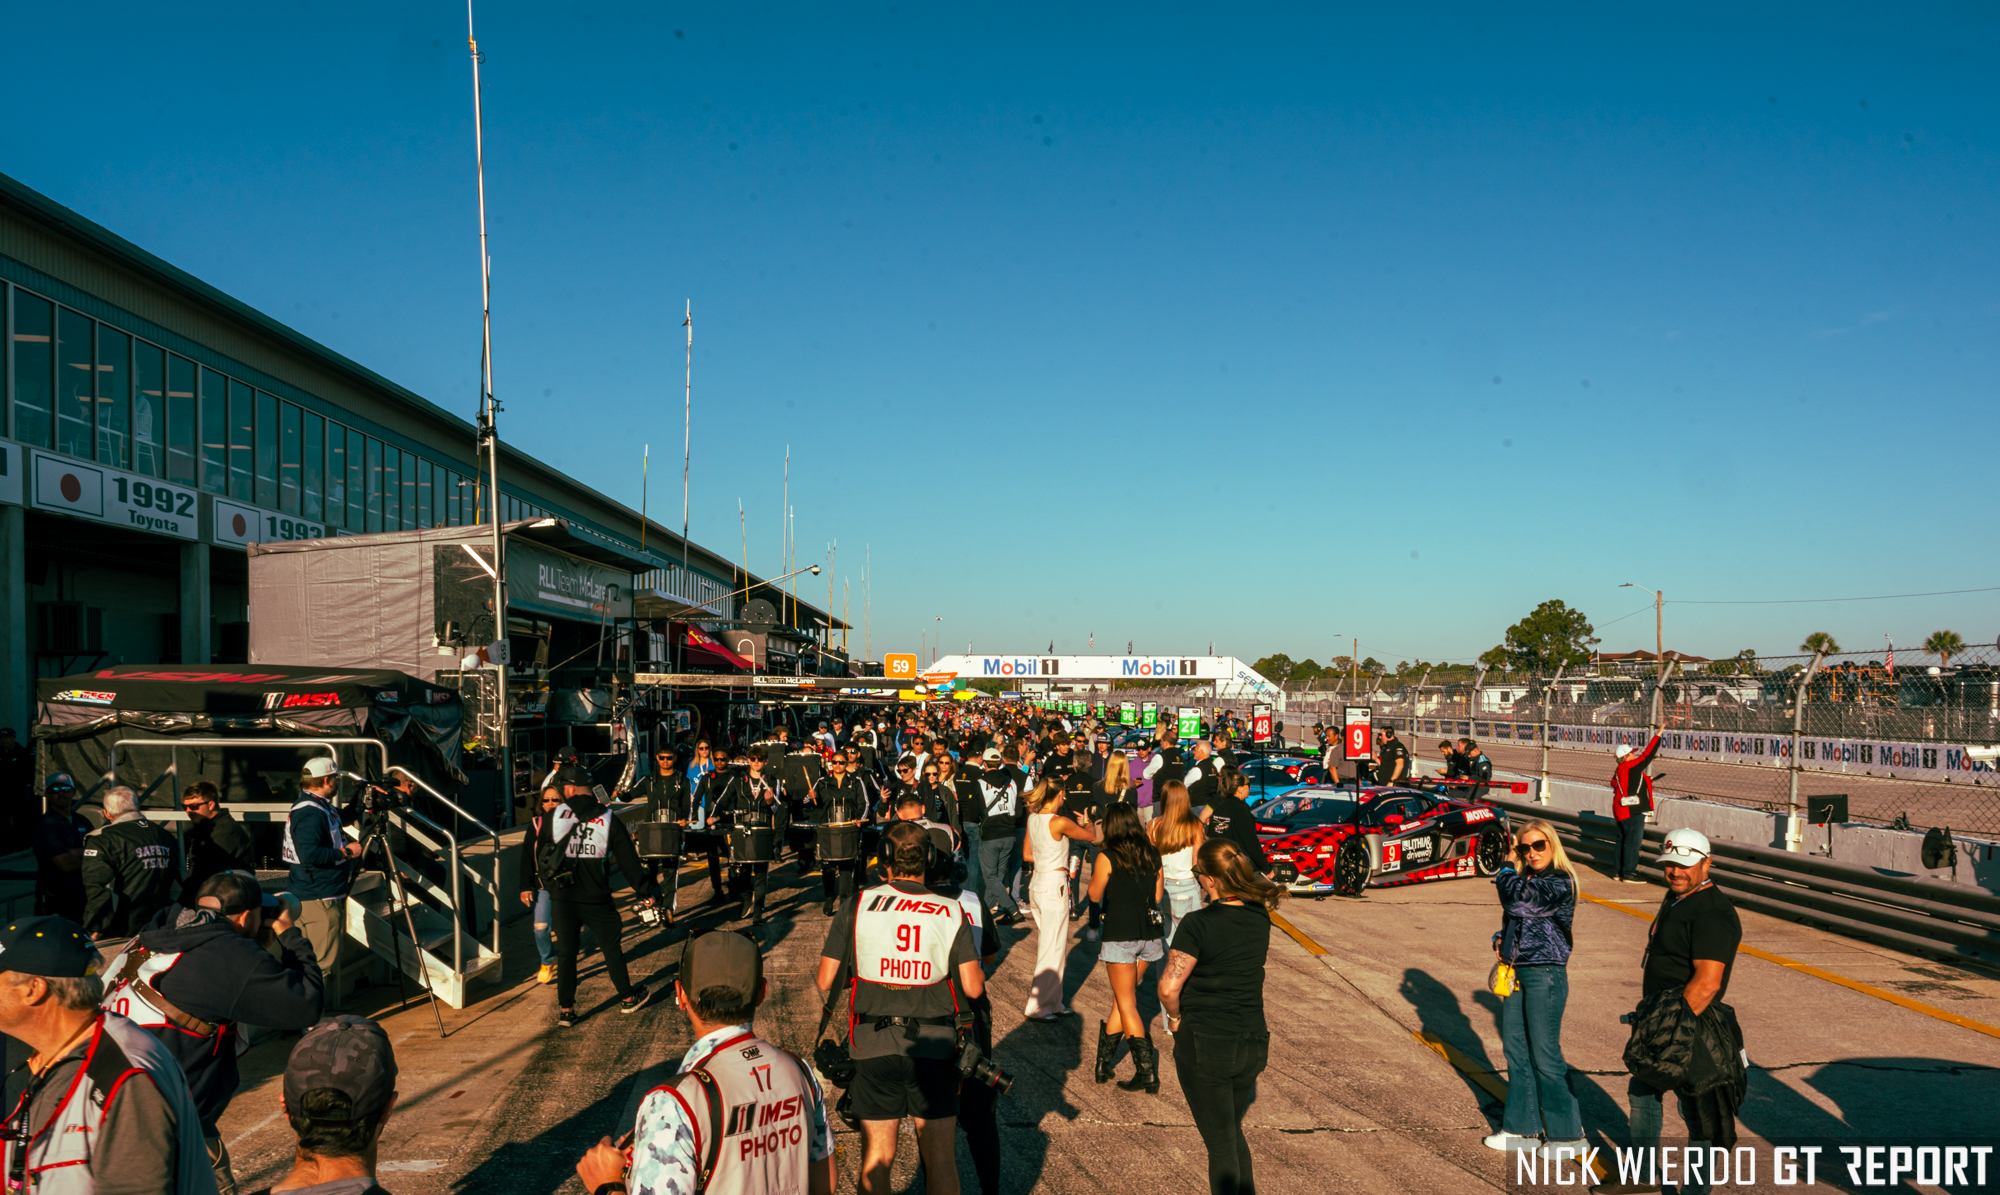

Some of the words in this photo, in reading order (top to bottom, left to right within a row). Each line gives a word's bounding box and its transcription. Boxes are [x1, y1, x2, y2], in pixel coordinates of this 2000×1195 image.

[112, 477, 195, 519] 1992
[127, 509, 178, 532] Toyota
[539, 564, 556, 590] RLL
[556, 568, 578, 595] Team
[892, 660, 909, 673] 59
[984, 658, 1036, 675] Mobil
[1122, 659, 1175, 676] Mobil
[283, 692, 340, 708] IMSA
[1122, 711, 1134, 721] 96
[1144, 712, 1155, 723] 57
[1181, 720, 1198, 733] 27
[1256, 720, 1269, 735] 48
[1353, 728, 1363, 750] 9
[1586, 729, 1604, 744] Mobil
[1616, 731, 1636, 746] Mobil
[1686, 734, 1710, 752] Mobil
[1726, 736, 1752, 754] Mobil
[1822, 742, 1858, 762] Mobil
[1880, 746, 1920, 768] Mobil
[1465, 808, 1494, 822] MOTUL
[136, 845, 170, 858] SAFETY
[569, 844, 596, 856] VIDEO
[1388, 846, 1396, 861] 9
[142, 858, 170, 869] TEAM
[894, 898, 951, 918] IMSA
[896, 924, 921, 952] 91
[880, 958, 931, 980] PHOTO
[742, 1048, 760, 1060] OMP
[749, 1064, 772, 1092] 17
[758, 1094, 807, 1127] IMSA
[740, 1124, 802, 1161] PHOTO
